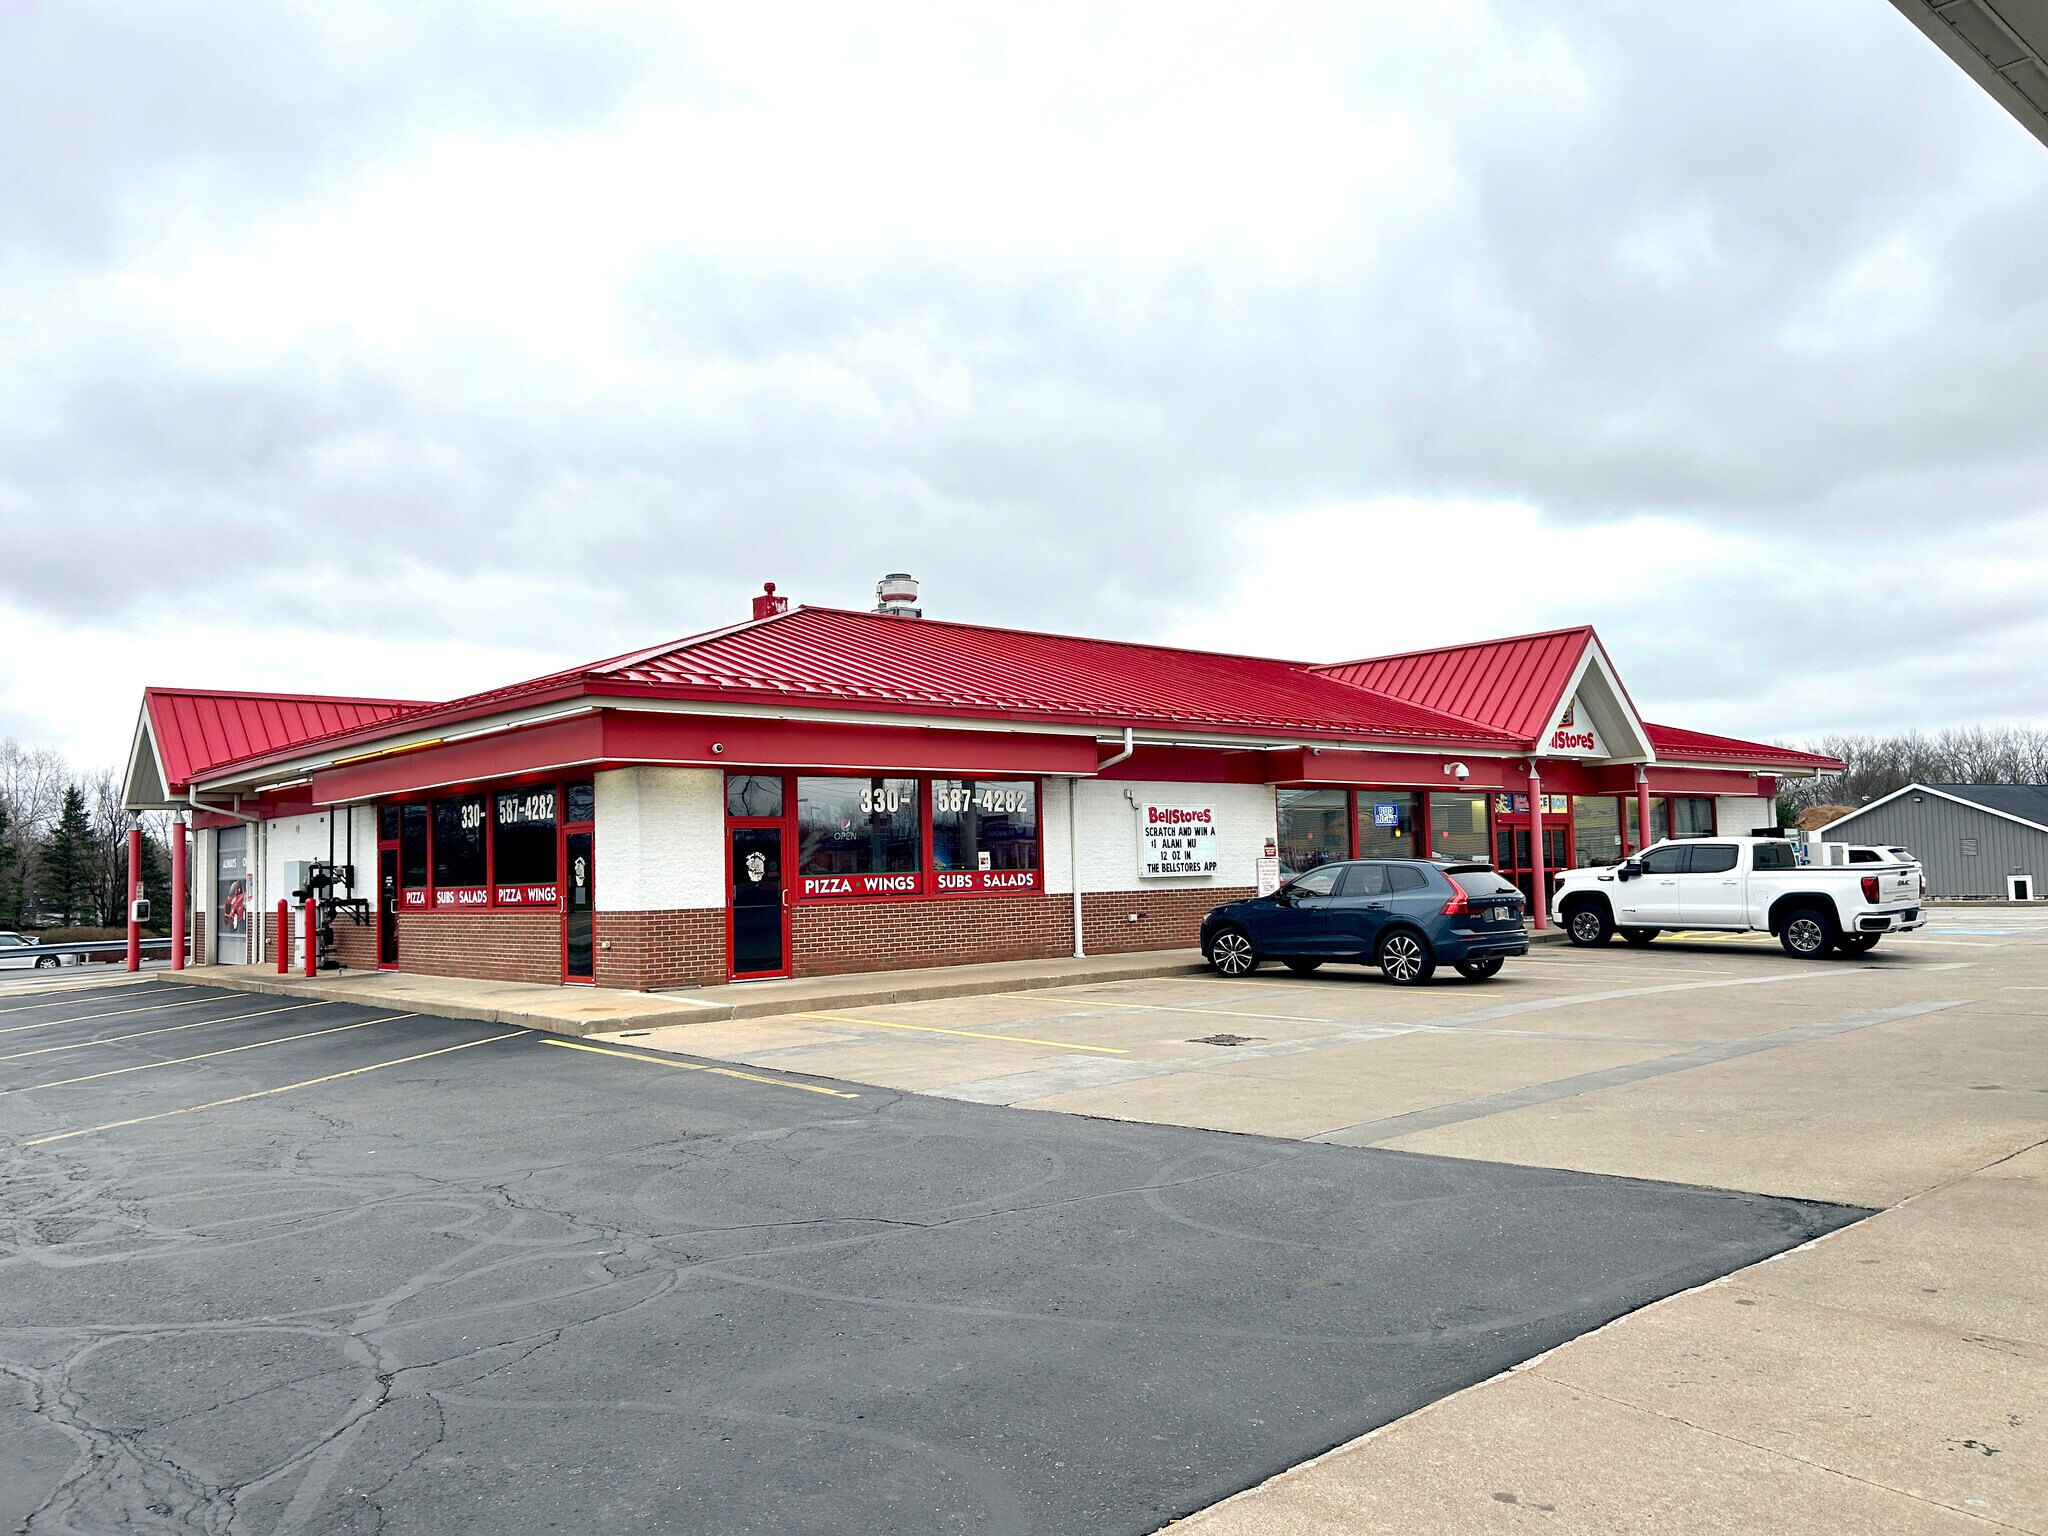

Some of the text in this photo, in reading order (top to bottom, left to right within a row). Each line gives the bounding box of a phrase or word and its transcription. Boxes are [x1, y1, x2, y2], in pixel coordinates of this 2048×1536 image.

[1549, 731, 1594, 750] llStores
[937, 788, 1027, 813] 587-4282
[499, 794, 554, 824] 587-4282
[1378, 806, 1394, 815] BUD
[1148, 807, 1212, 824] BellStores
[1376, 815, 1397, 824] LIGHT
[833, 832, 857, 841] OPEN
[1145, 826, 1216, 837] SCRATCH AND WIN A
[1162, 839, 1182, 848] ALANI
[1187, 839, 1197, 848] NU
[1160, 851, 1168, 860] 12
[1184, 851, 1191, 860] IN
[1147, 862, 1217, 873] THE BELLSTORES APP
[804, 875, 915, 894] PIZZA WINGS
[937, 873, 1034, 888] SUBS SALADS
[406, 892, 425, 904] PIZZA
[436, 890, 487, 903] SUBS SALADS
[498, 887, 557, 902] PIZZA WINGS
